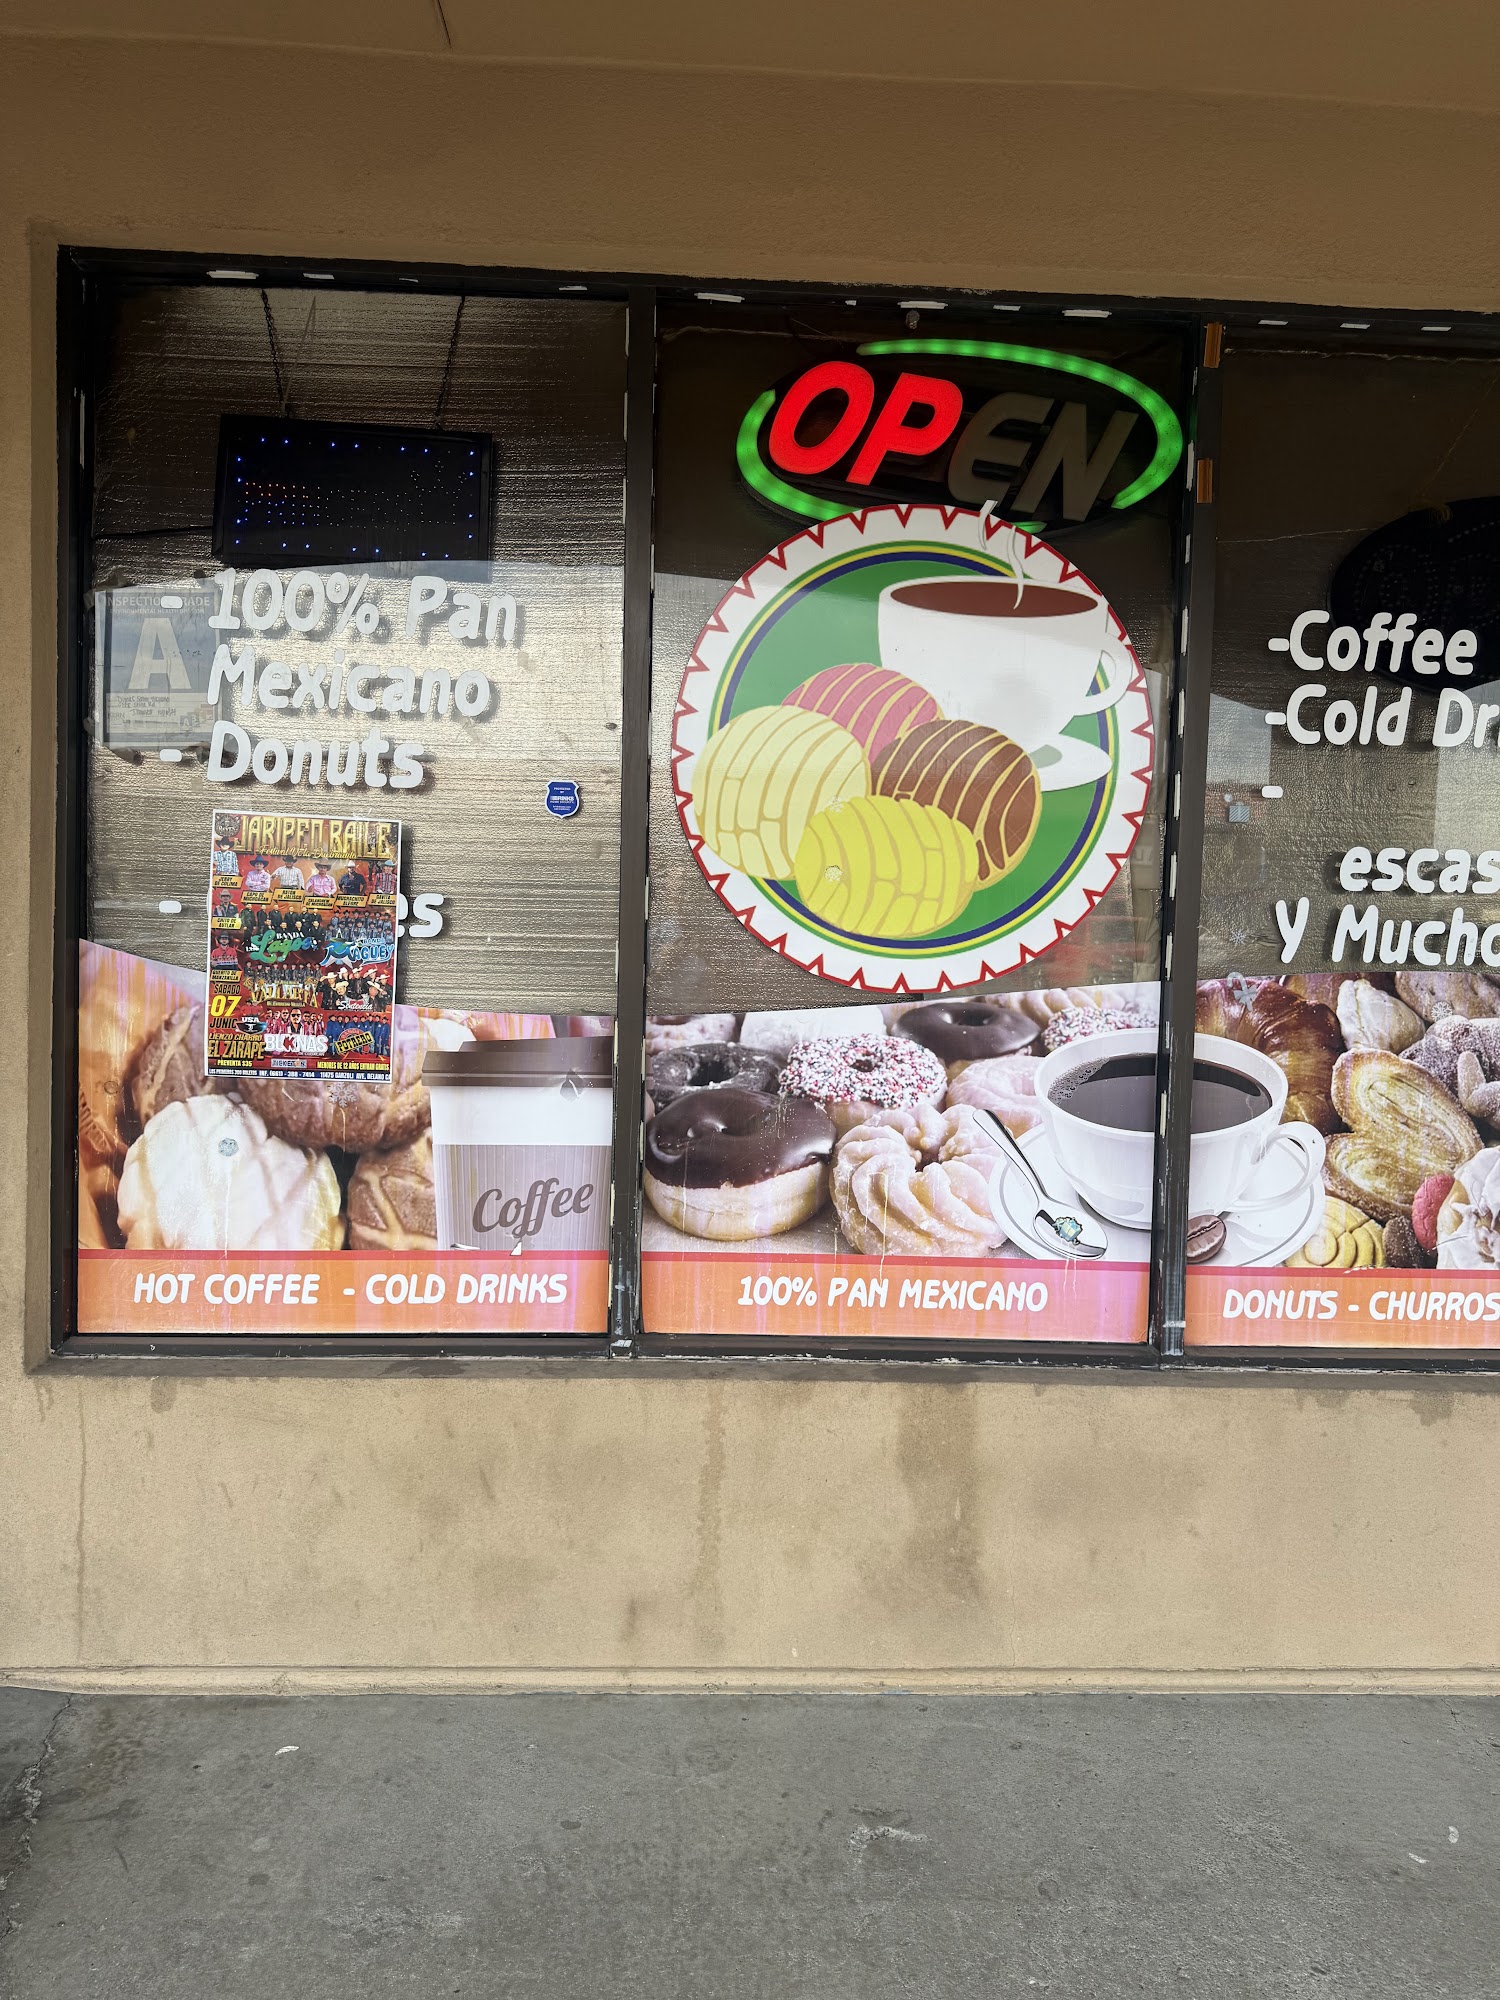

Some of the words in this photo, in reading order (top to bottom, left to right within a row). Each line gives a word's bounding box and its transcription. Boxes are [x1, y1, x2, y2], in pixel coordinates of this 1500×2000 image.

[768, 360, 1139, 522] OPEN
[107, 596, 161, 606] NSPECTIO
[181, 596, 210, 606] RADE
[208, 567, 380, 635] 100%
[406, 575, 516, 642] Pan
[128, 617, 192, 689] A
[1268, 609, 1478, 675] -Coffee
[207, 644, 490, 717] Mexicano
[1264, 684, 1412, 746] -Cold
[1433, 687, 1500, 748] Dr
[208, 720, 424, 789] Donuts
[329, 820, 391, 859] BAILE
[210, 995, 242, 1017] 07
[208, 1040, 220, 1058] EL
[222, 1041, 266, 1060] ZARAPE
[336, 1032, 373, 1053] POTRERO
[217, 1059, 241, 1067] PREVENTA
[472, 1177, 594, 1239] Coffee
[134, 1273, 197, 1304] HOT
[204, 1273, 319, 1305] COFFEE
[365, 1274, 446, 1305] COLD
[456, 1274, 568, 1305] DRINKS
[737, 1275, 817, 1308] 100%
[829, 1277, 890, 1310] PAN
[898, 1278, 1049, 1312] MEXICANO
[1222, 1289, 1339, 1320] DONUTS
[1369, 1291, 1500, 1321] CHURROS
